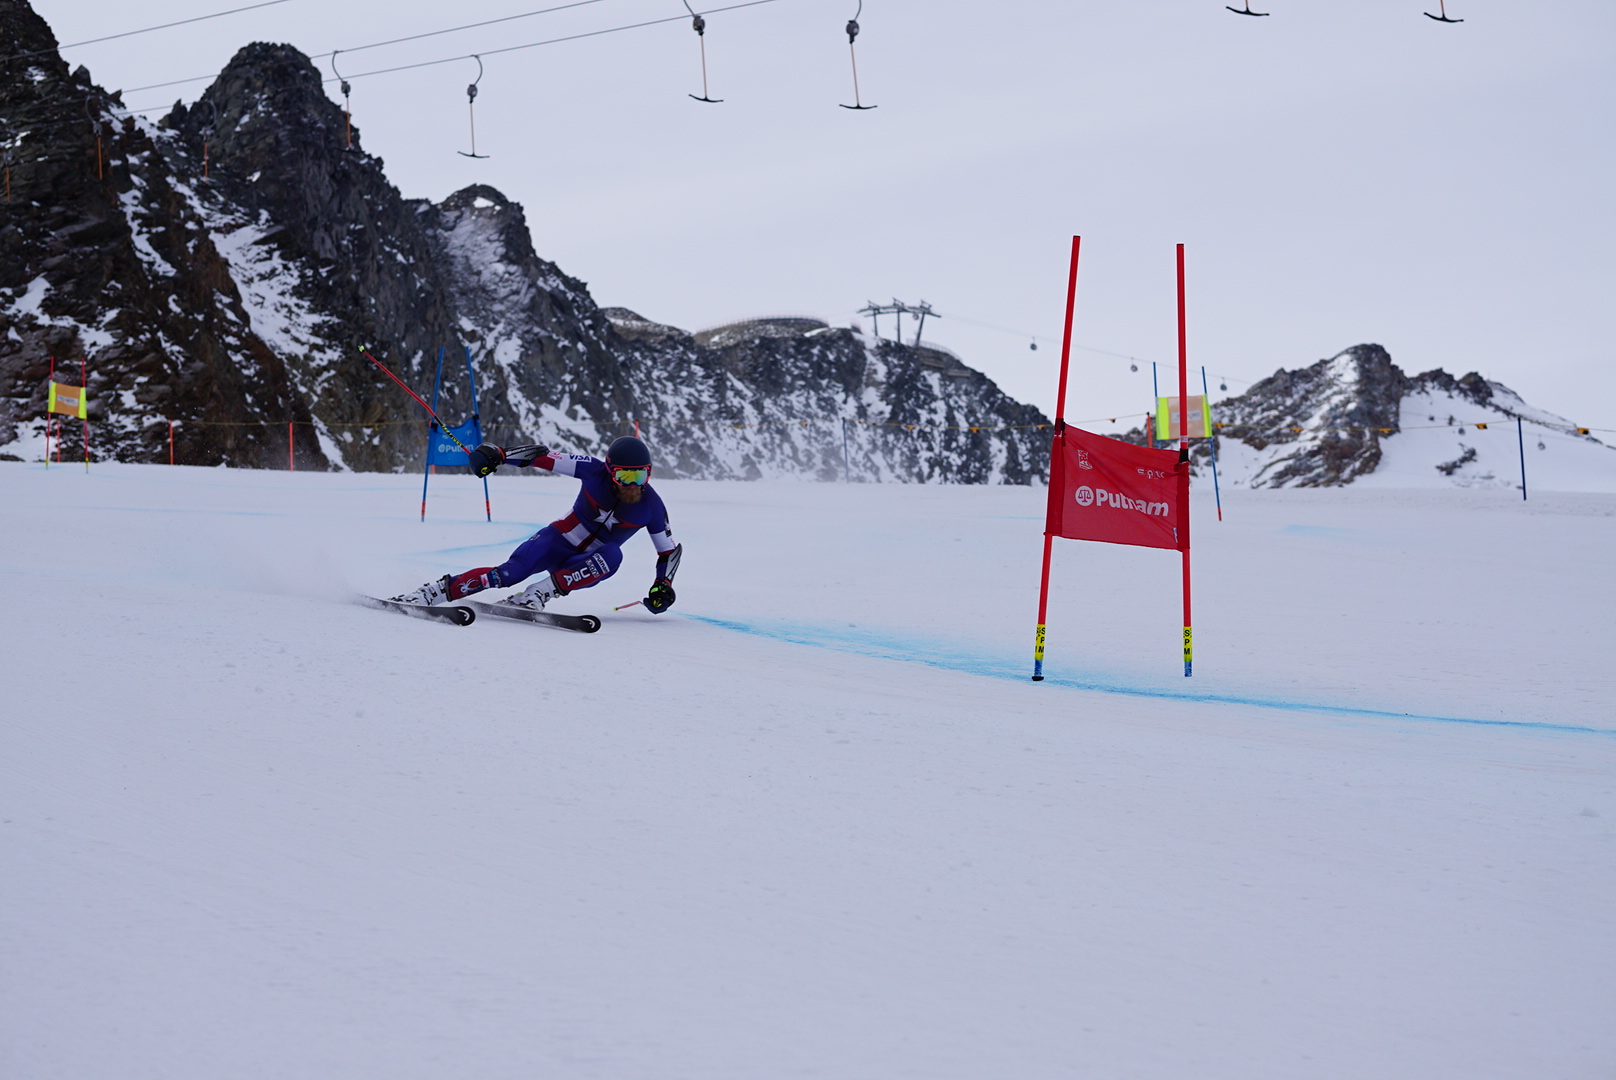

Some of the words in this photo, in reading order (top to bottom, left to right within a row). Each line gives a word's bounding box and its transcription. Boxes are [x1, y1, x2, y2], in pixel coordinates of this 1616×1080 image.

[445, 444, 474, 453] Putm
[1096, 488, 1169, 517] Putnam
[563, 567, 590, 586] USA
